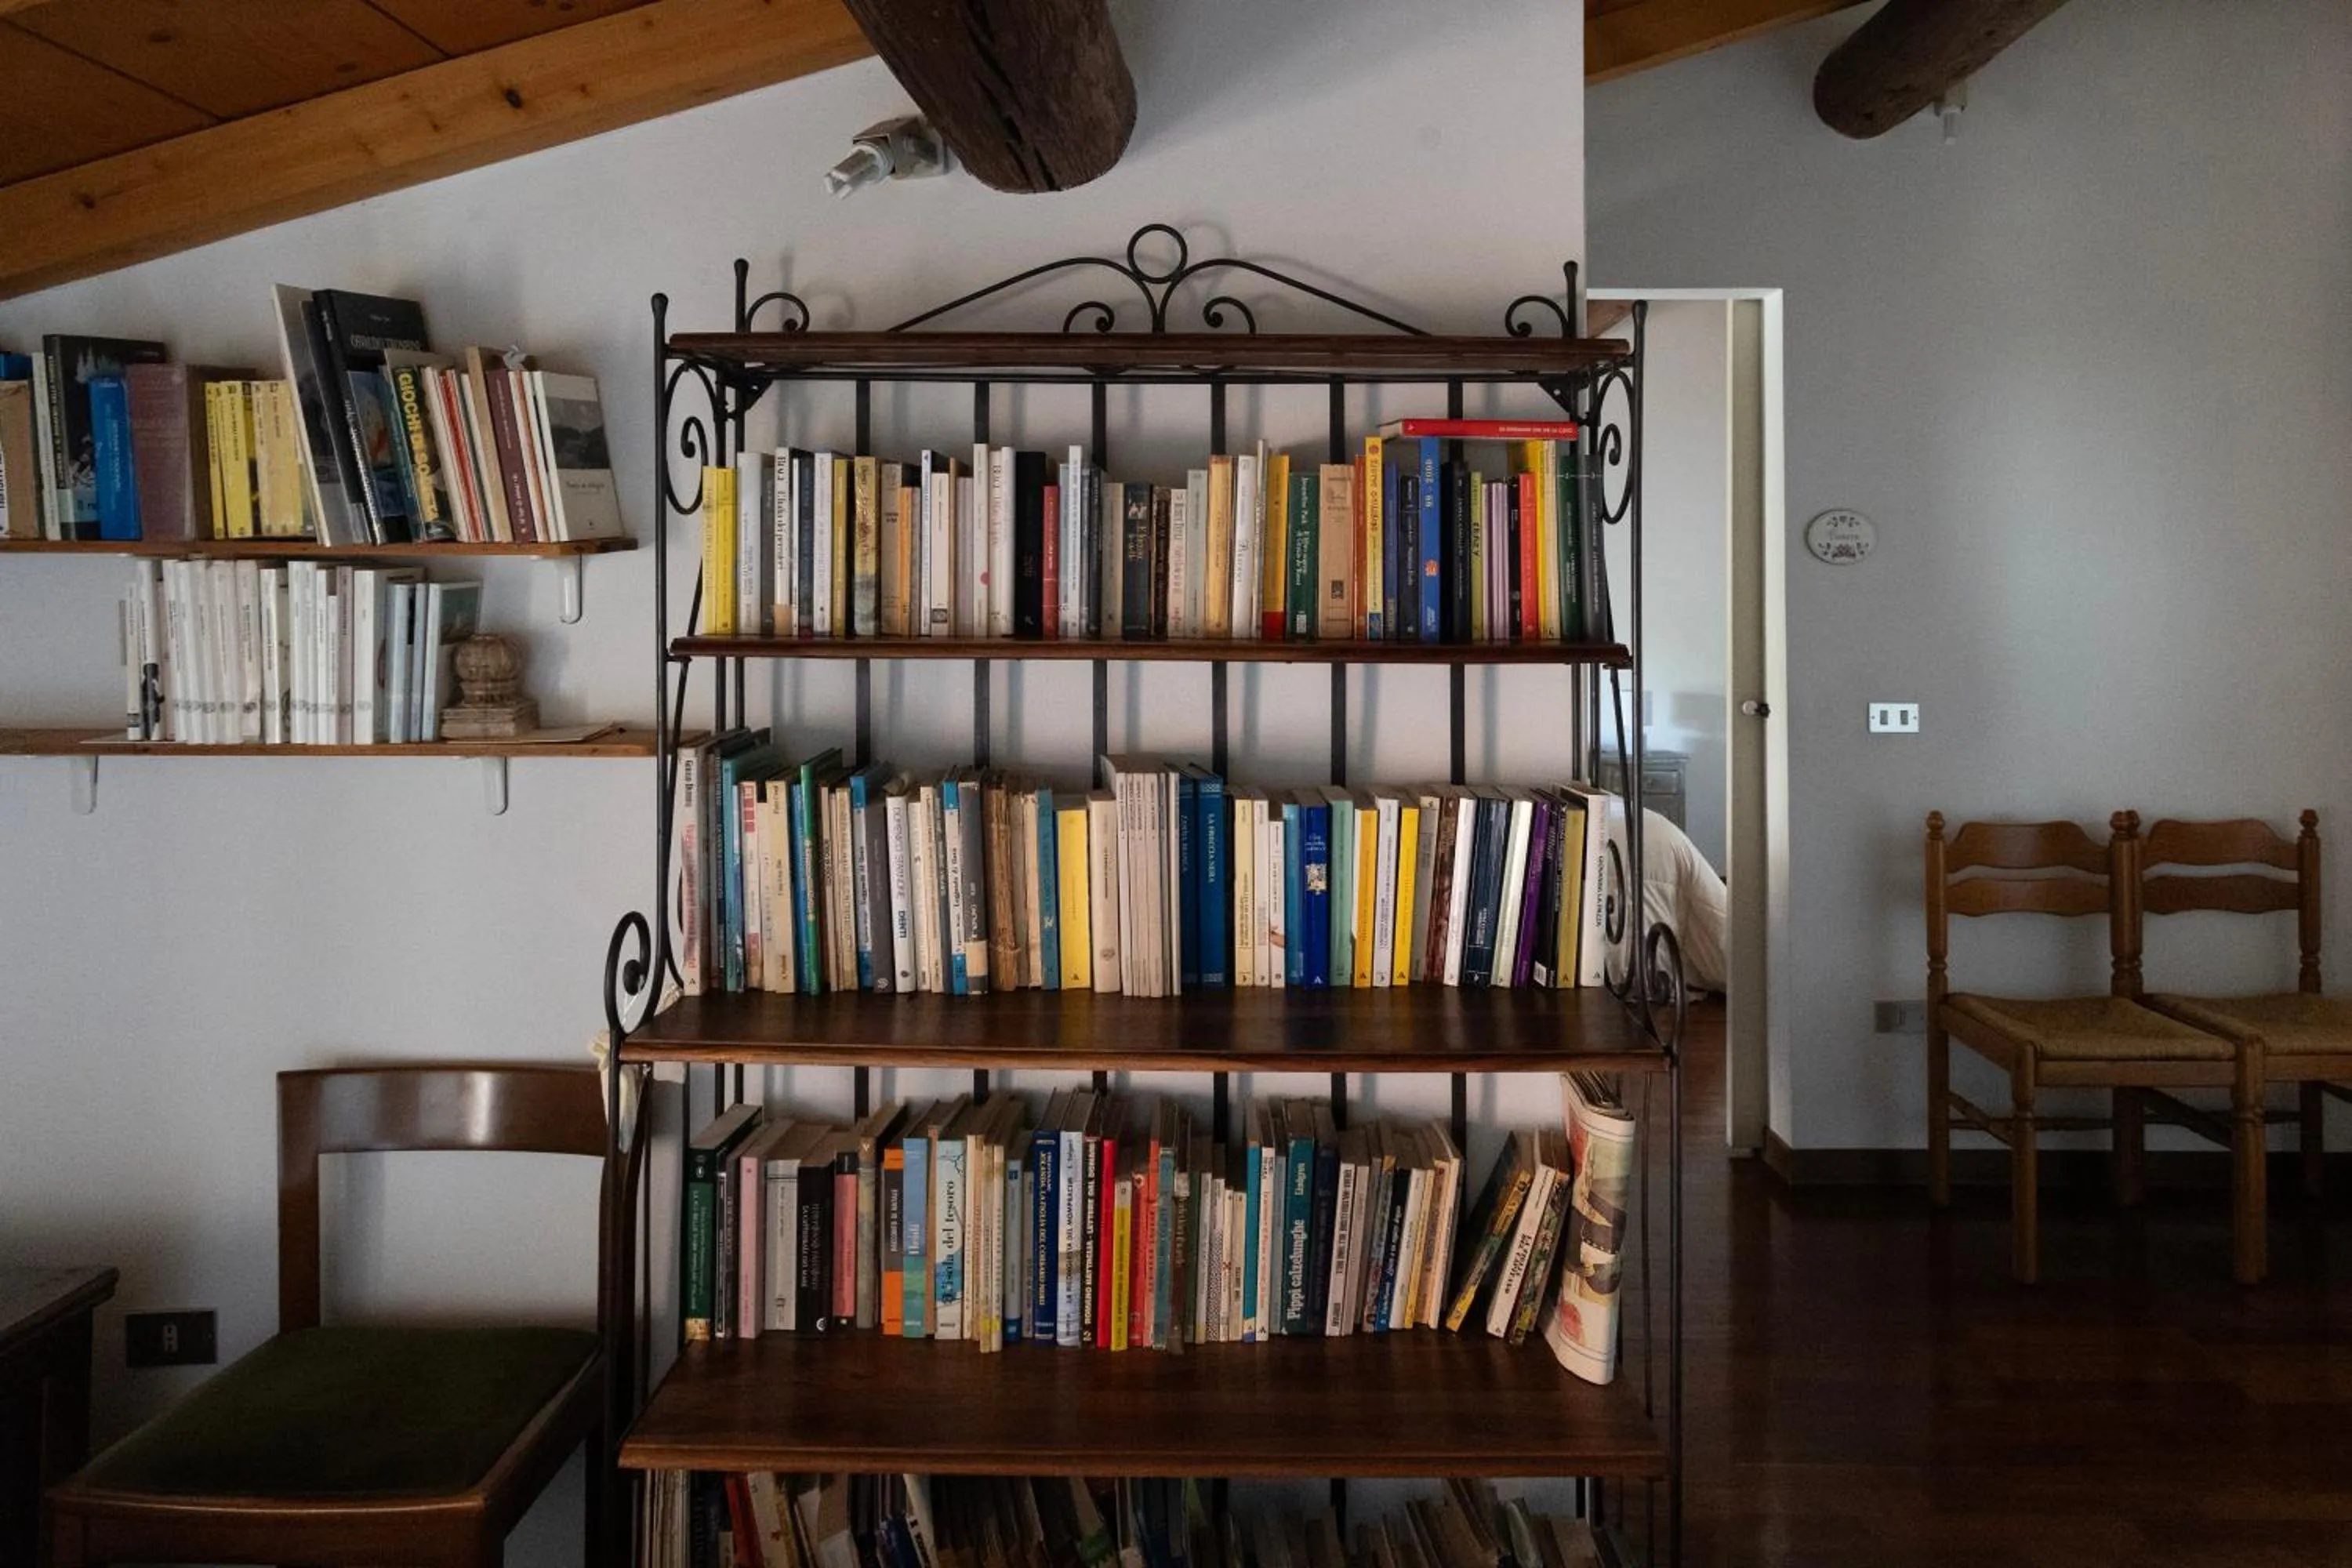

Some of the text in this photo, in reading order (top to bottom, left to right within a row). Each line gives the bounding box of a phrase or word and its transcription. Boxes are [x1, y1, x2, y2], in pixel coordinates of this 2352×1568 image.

[397, 372, 422, 431] GIOCHI
[891, 807, 907, 938] DOMENICO STARNONE DENTI
[1288, 1218, 1308, 1287] calzelunghe
[1286, 1288, 1305, 1320] Pippi
